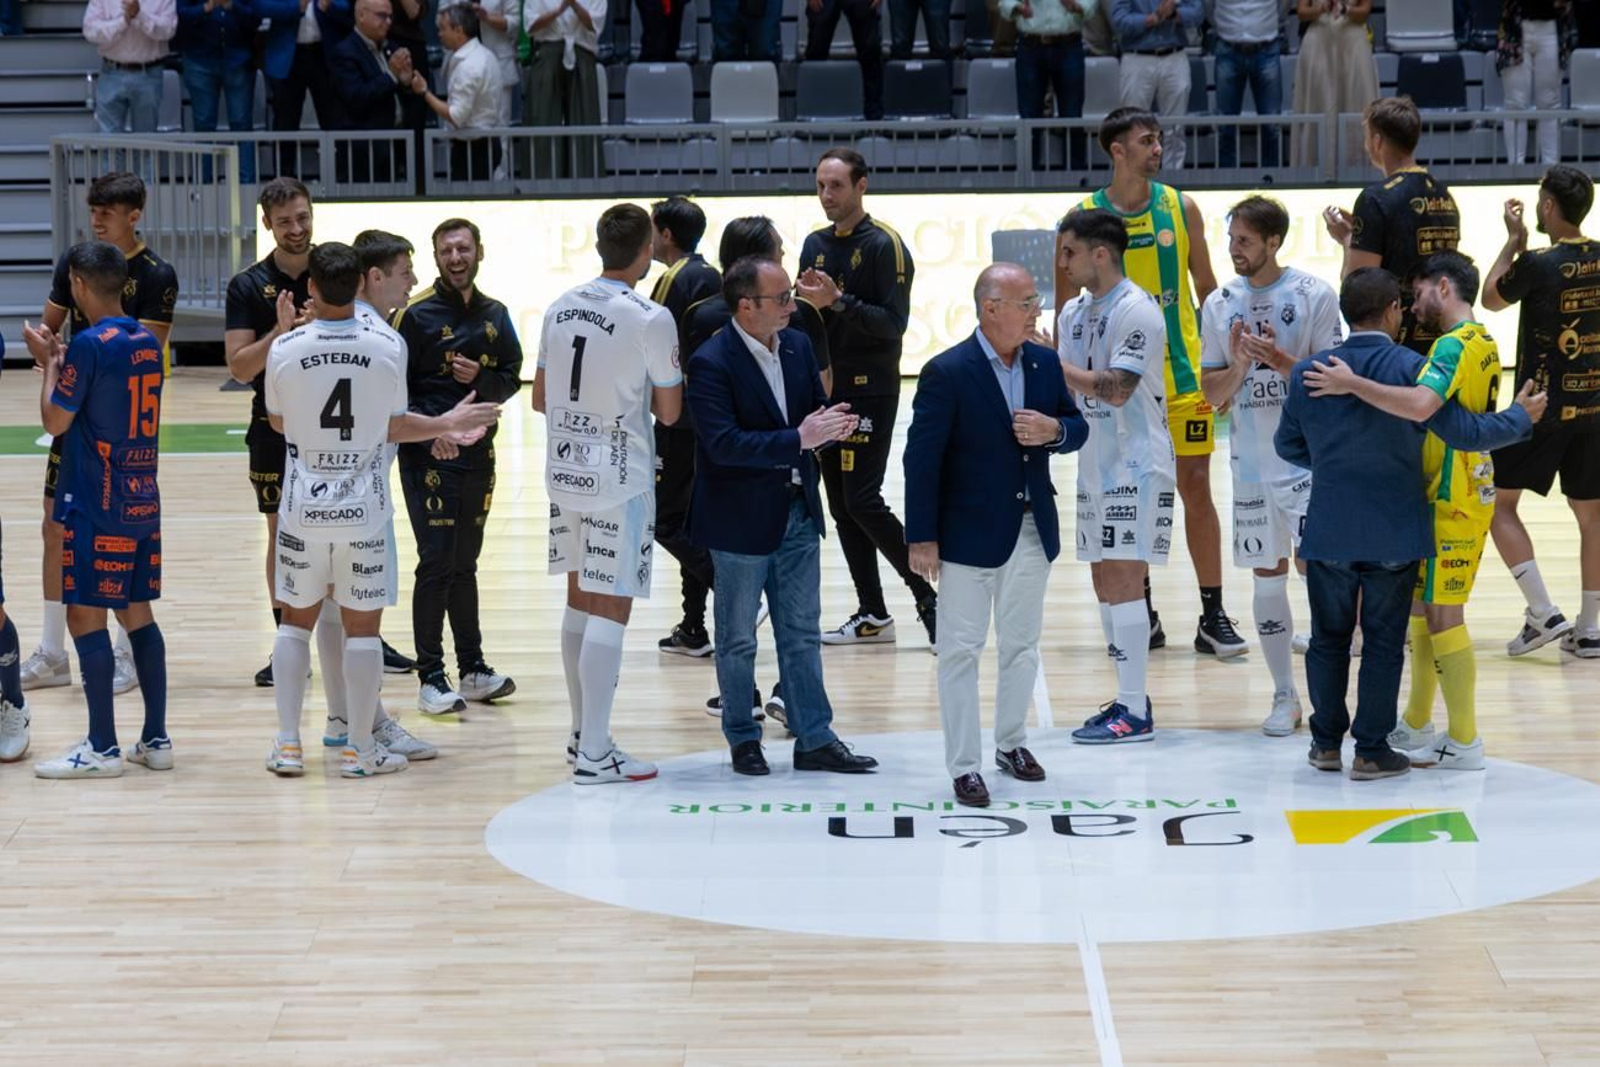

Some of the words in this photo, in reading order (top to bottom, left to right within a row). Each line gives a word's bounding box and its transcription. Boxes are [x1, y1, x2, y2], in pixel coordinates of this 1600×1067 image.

[556, 309, 616, 335] ESPINDOLA
[300, 352, 371, 370] ESTEBAN
[570, 335, 587, 401] 1
[128, 373, 161, 439] 15
[320, 378, 354, 441] 4
[611, 430, 619, 443] DE
[1189, 424, 1205, 436] LZ
[318, 453, 360, 465] FRIZZ
[611, 443, 619, 466] JAÉN
[619, 430, 629, 485] DIPUTACIÓN
[552, 473, 594, 488] XPECADO
[304, 507, 364, 520] XPECADO
[349, 539, 385, 550] MONGAR
[669, 802, 953, 813] INTERIOR
[828, 811, 1254, 848] Jaén
